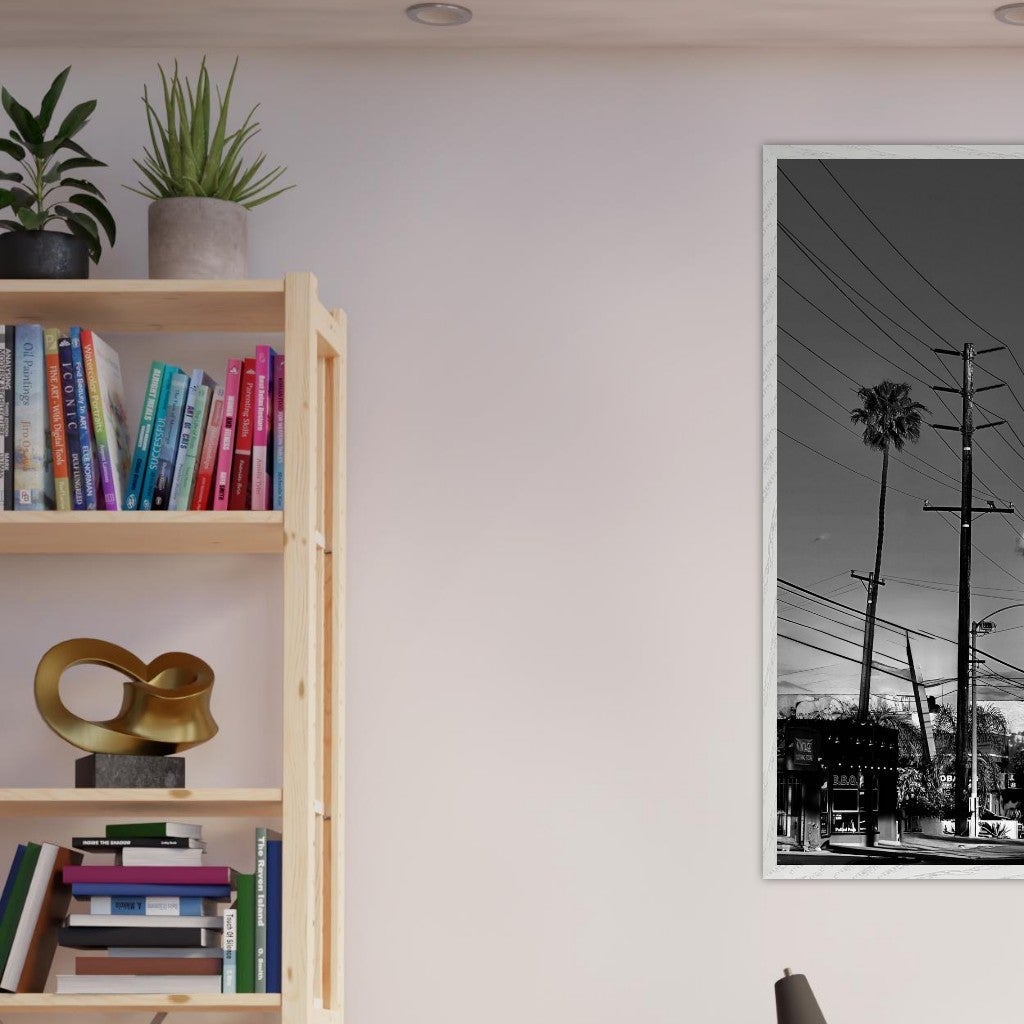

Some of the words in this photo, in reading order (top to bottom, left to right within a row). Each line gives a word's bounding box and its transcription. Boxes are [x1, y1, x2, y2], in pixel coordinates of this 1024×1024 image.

[22, 342, 33, 356] Oil
[20, 360, 33, 406] Paintings
[48, 365, 57, 383] FINE
[50, 384, 58, 399] ART
[62, 362, 77, 430] ICONIC
[82, 344, 98, 393] Watercolor
[90, 395, 104, 432] Portraits
[242, 382, 252, 416] Parenting
[52, 405, 60, 422] With
[78, 415, 86, 429] ART
[224, 416, 232, 428] AND
[52, 423, 62, 447] Digital
[241, 418, 249, 437] Skills
[148, 416, 166, 470] SUCCESSFUL
[55, 448, 64, 465] Tools
[83, 463, 93, 496] NORMAN
[257, 836, 265, 856] The
[257, 860, 265, 891] Raven
[257, 894, 265, 926] Island
[226, 939, 234, 959] Silence
